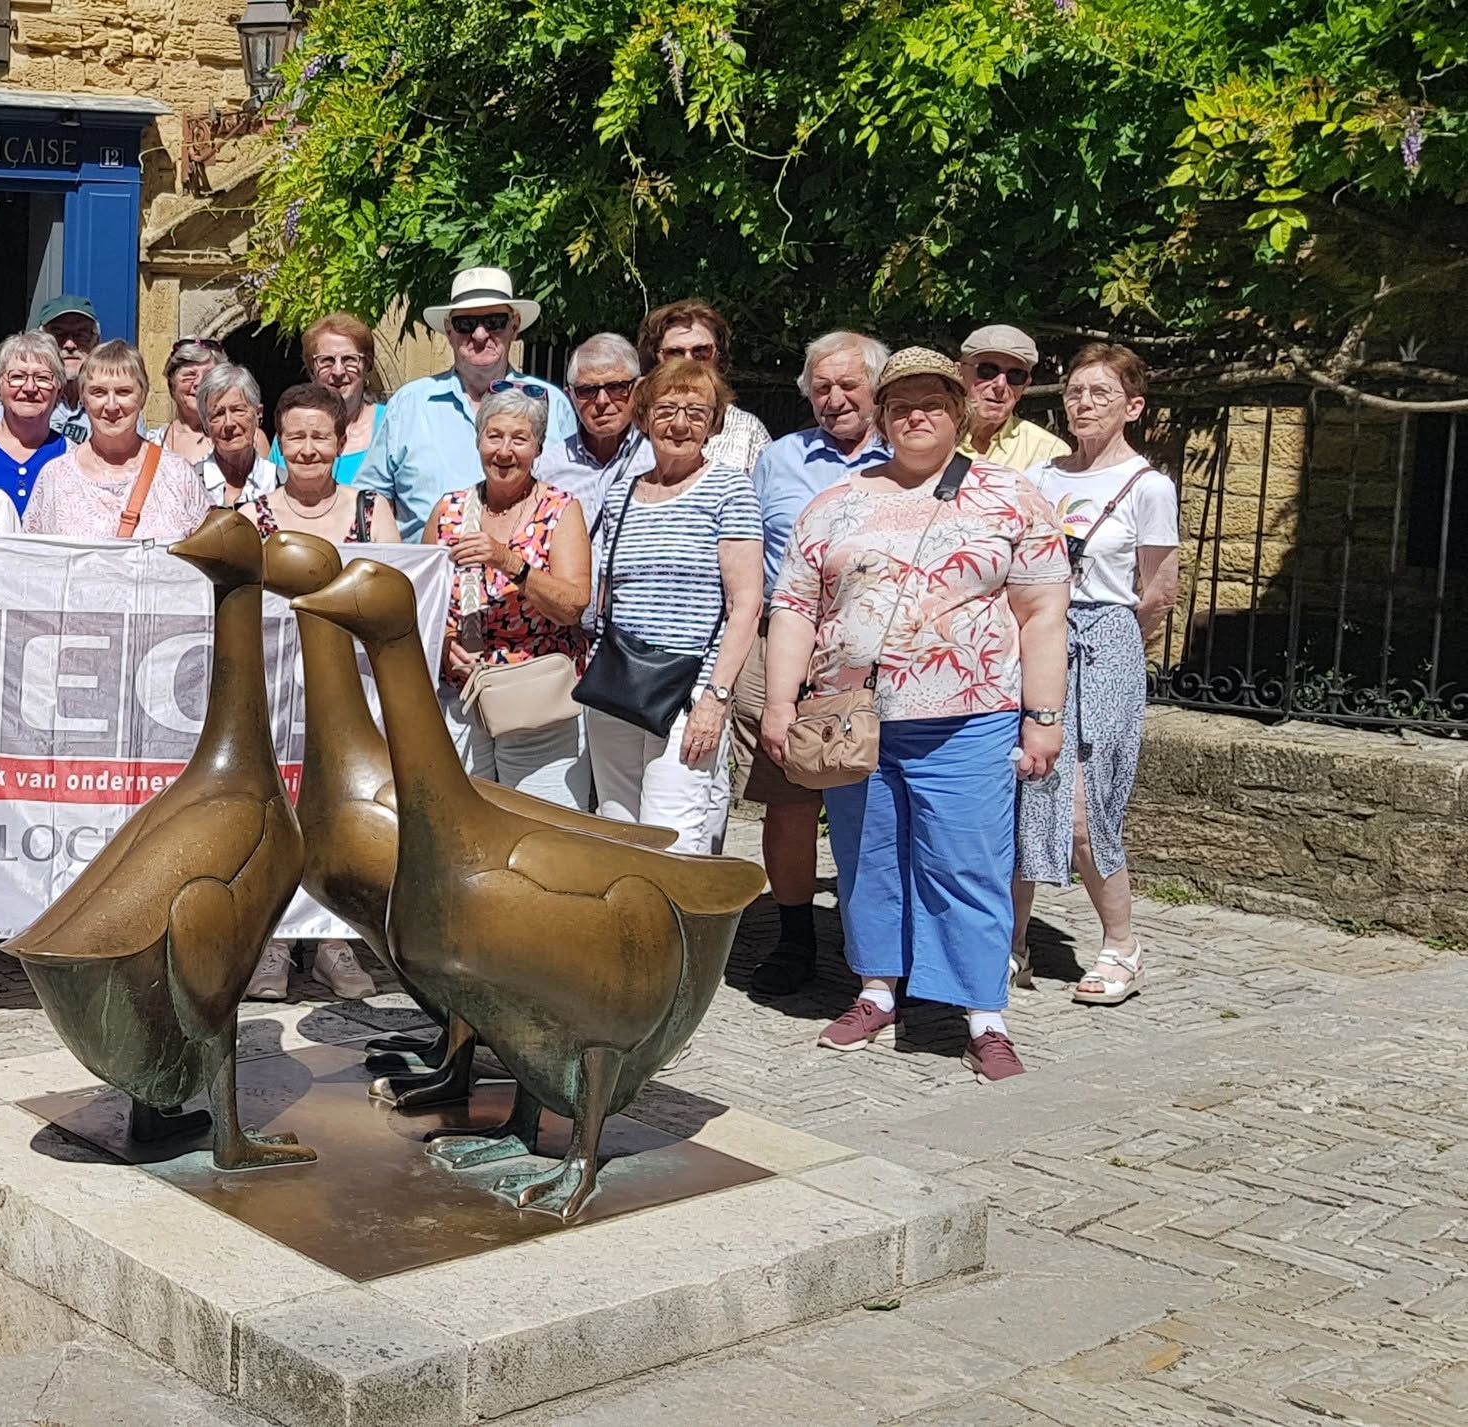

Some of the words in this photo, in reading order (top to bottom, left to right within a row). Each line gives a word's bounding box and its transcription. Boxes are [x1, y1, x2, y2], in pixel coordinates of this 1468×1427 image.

[104, 149, 120, 166] 12
[16, 771, 57, 789] van
[67, 770, 177, 792] onderne
